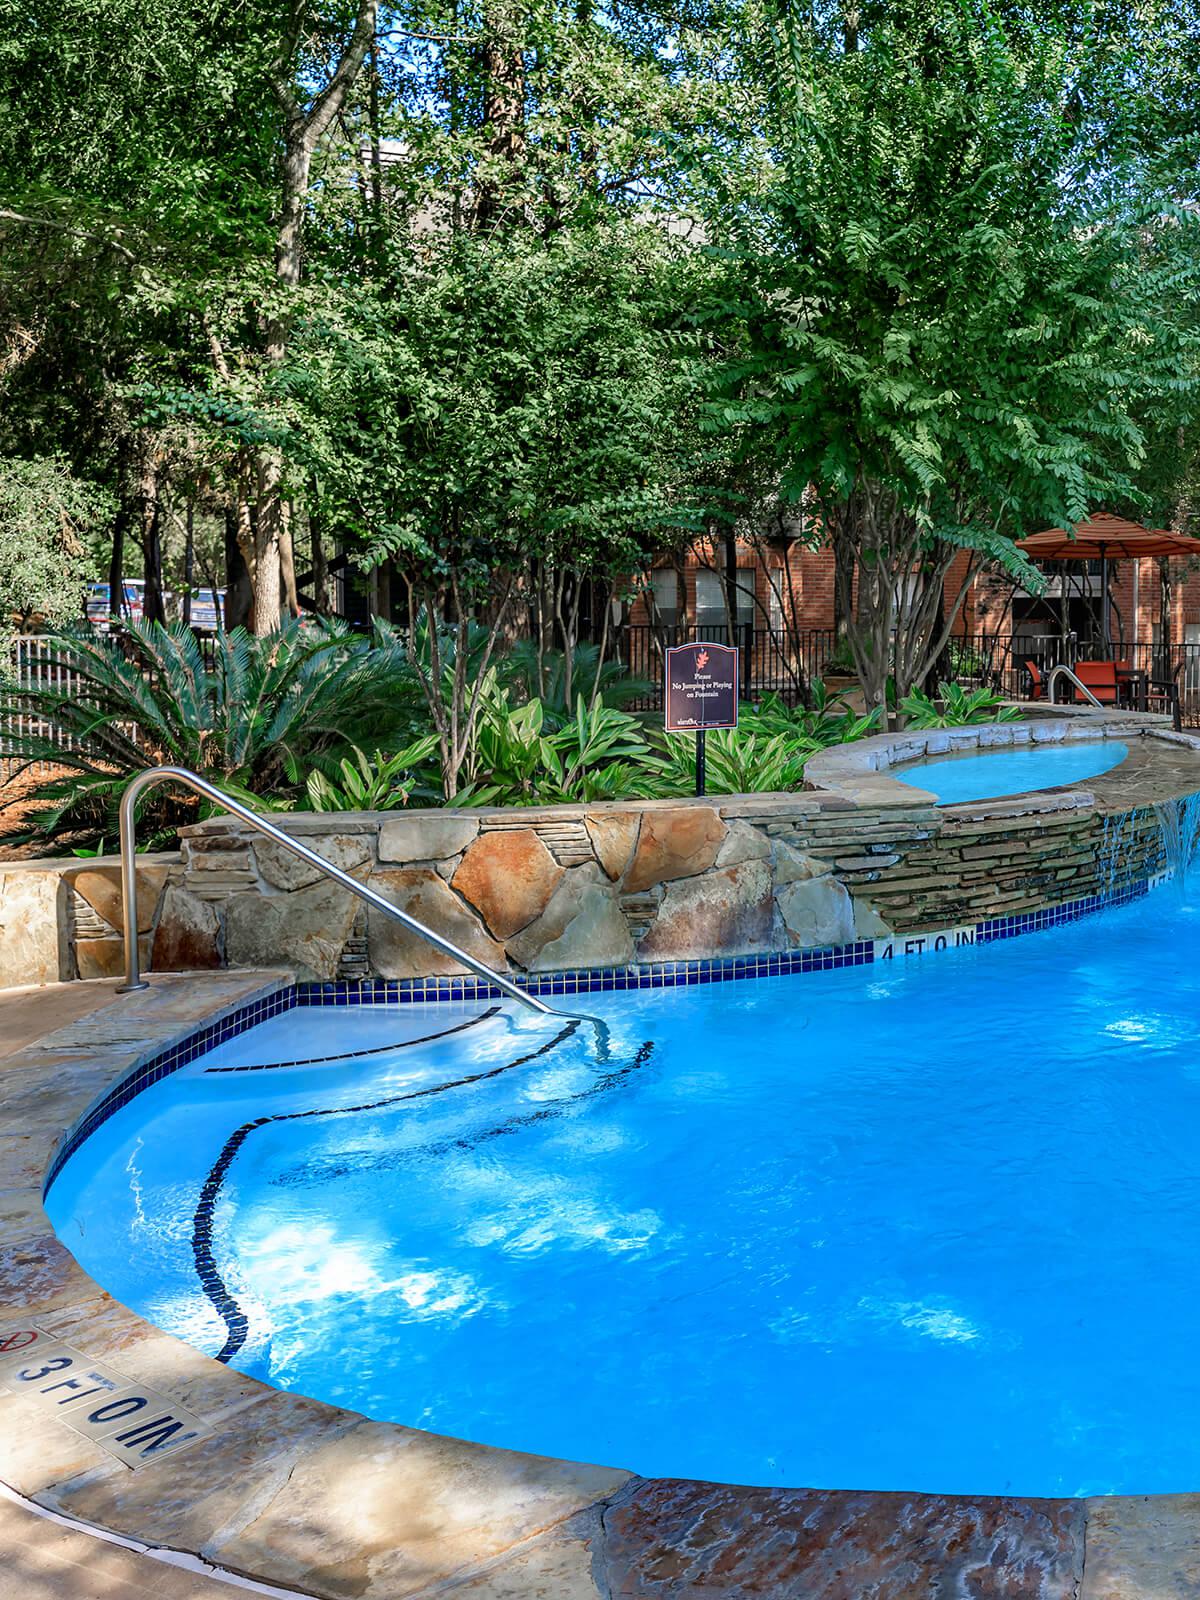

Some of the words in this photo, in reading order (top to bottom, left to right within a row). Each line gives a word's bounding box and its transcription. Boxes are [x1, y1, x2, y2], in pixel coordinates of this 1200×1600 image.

[672, 682, 682, 690] No
[682, 683, 706, 691] Jumping
[712, 681, 733, 690] Playing
[881, 943, 893, 960] 4
[904, 938, 926, 955] FT
[934, 935, 947, 952] 0
[956, 930, 974, 947] IN
[16, 1357, 73, 1381] 3
[40, 1372, 117, 1405] FT
[87, 1397, 148, 1423] 0
[115, 1415, 198, 1458] IN
